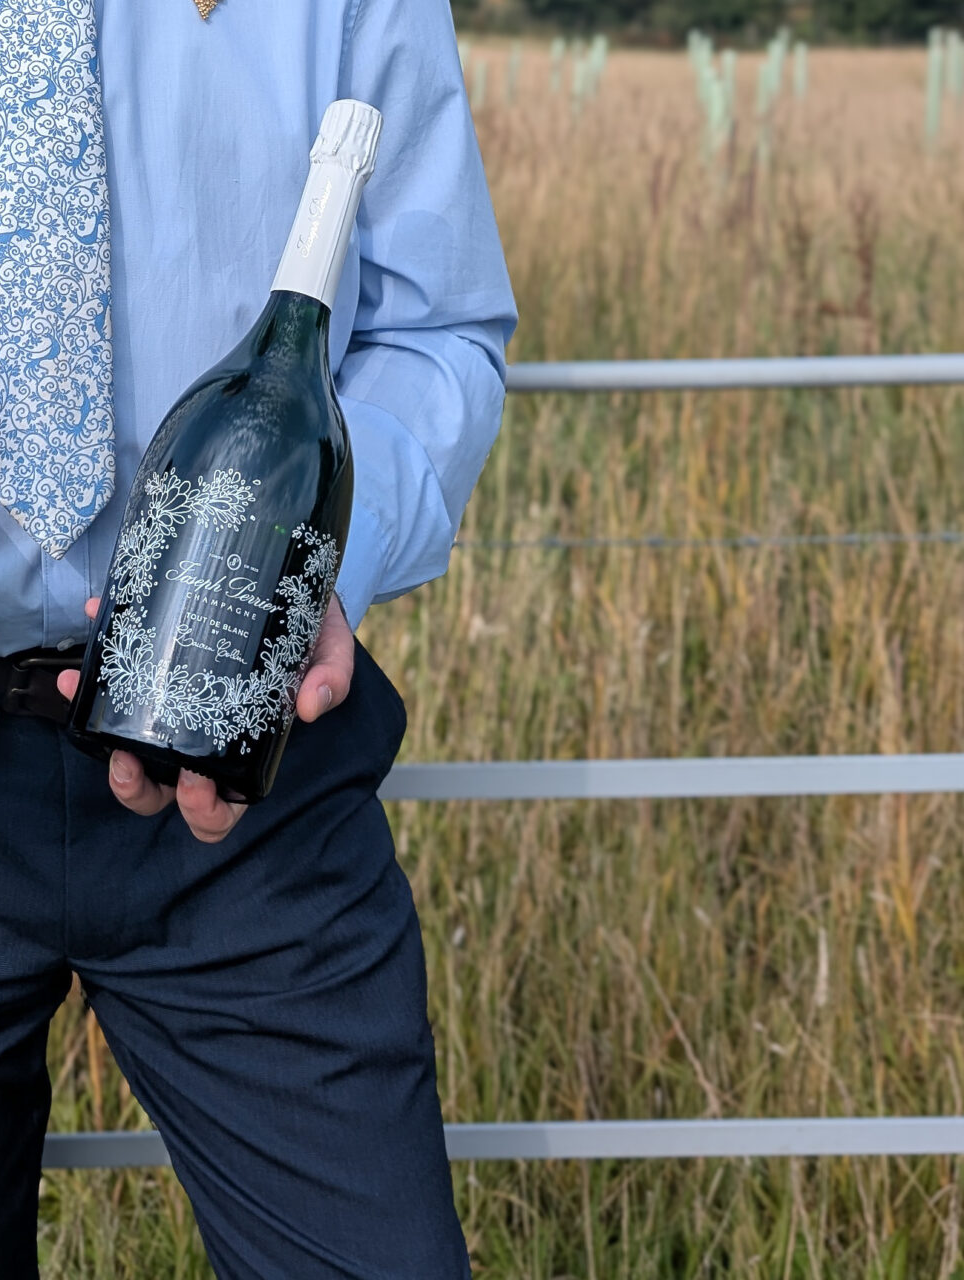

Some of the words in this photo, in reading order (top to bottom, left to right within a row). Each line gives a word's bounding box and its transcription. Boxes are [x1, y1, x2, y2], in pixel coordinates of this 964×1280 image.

[165, 560, 227, 592] Joseph
[225, 576, 285, 613] Perrier
[186, 591, 257, 621] CHAMPAGNE
[186, 612, 208, 624] TOUT
[209, 619, 221, 628] DE
[222, 623, 250, 639] BLANC
